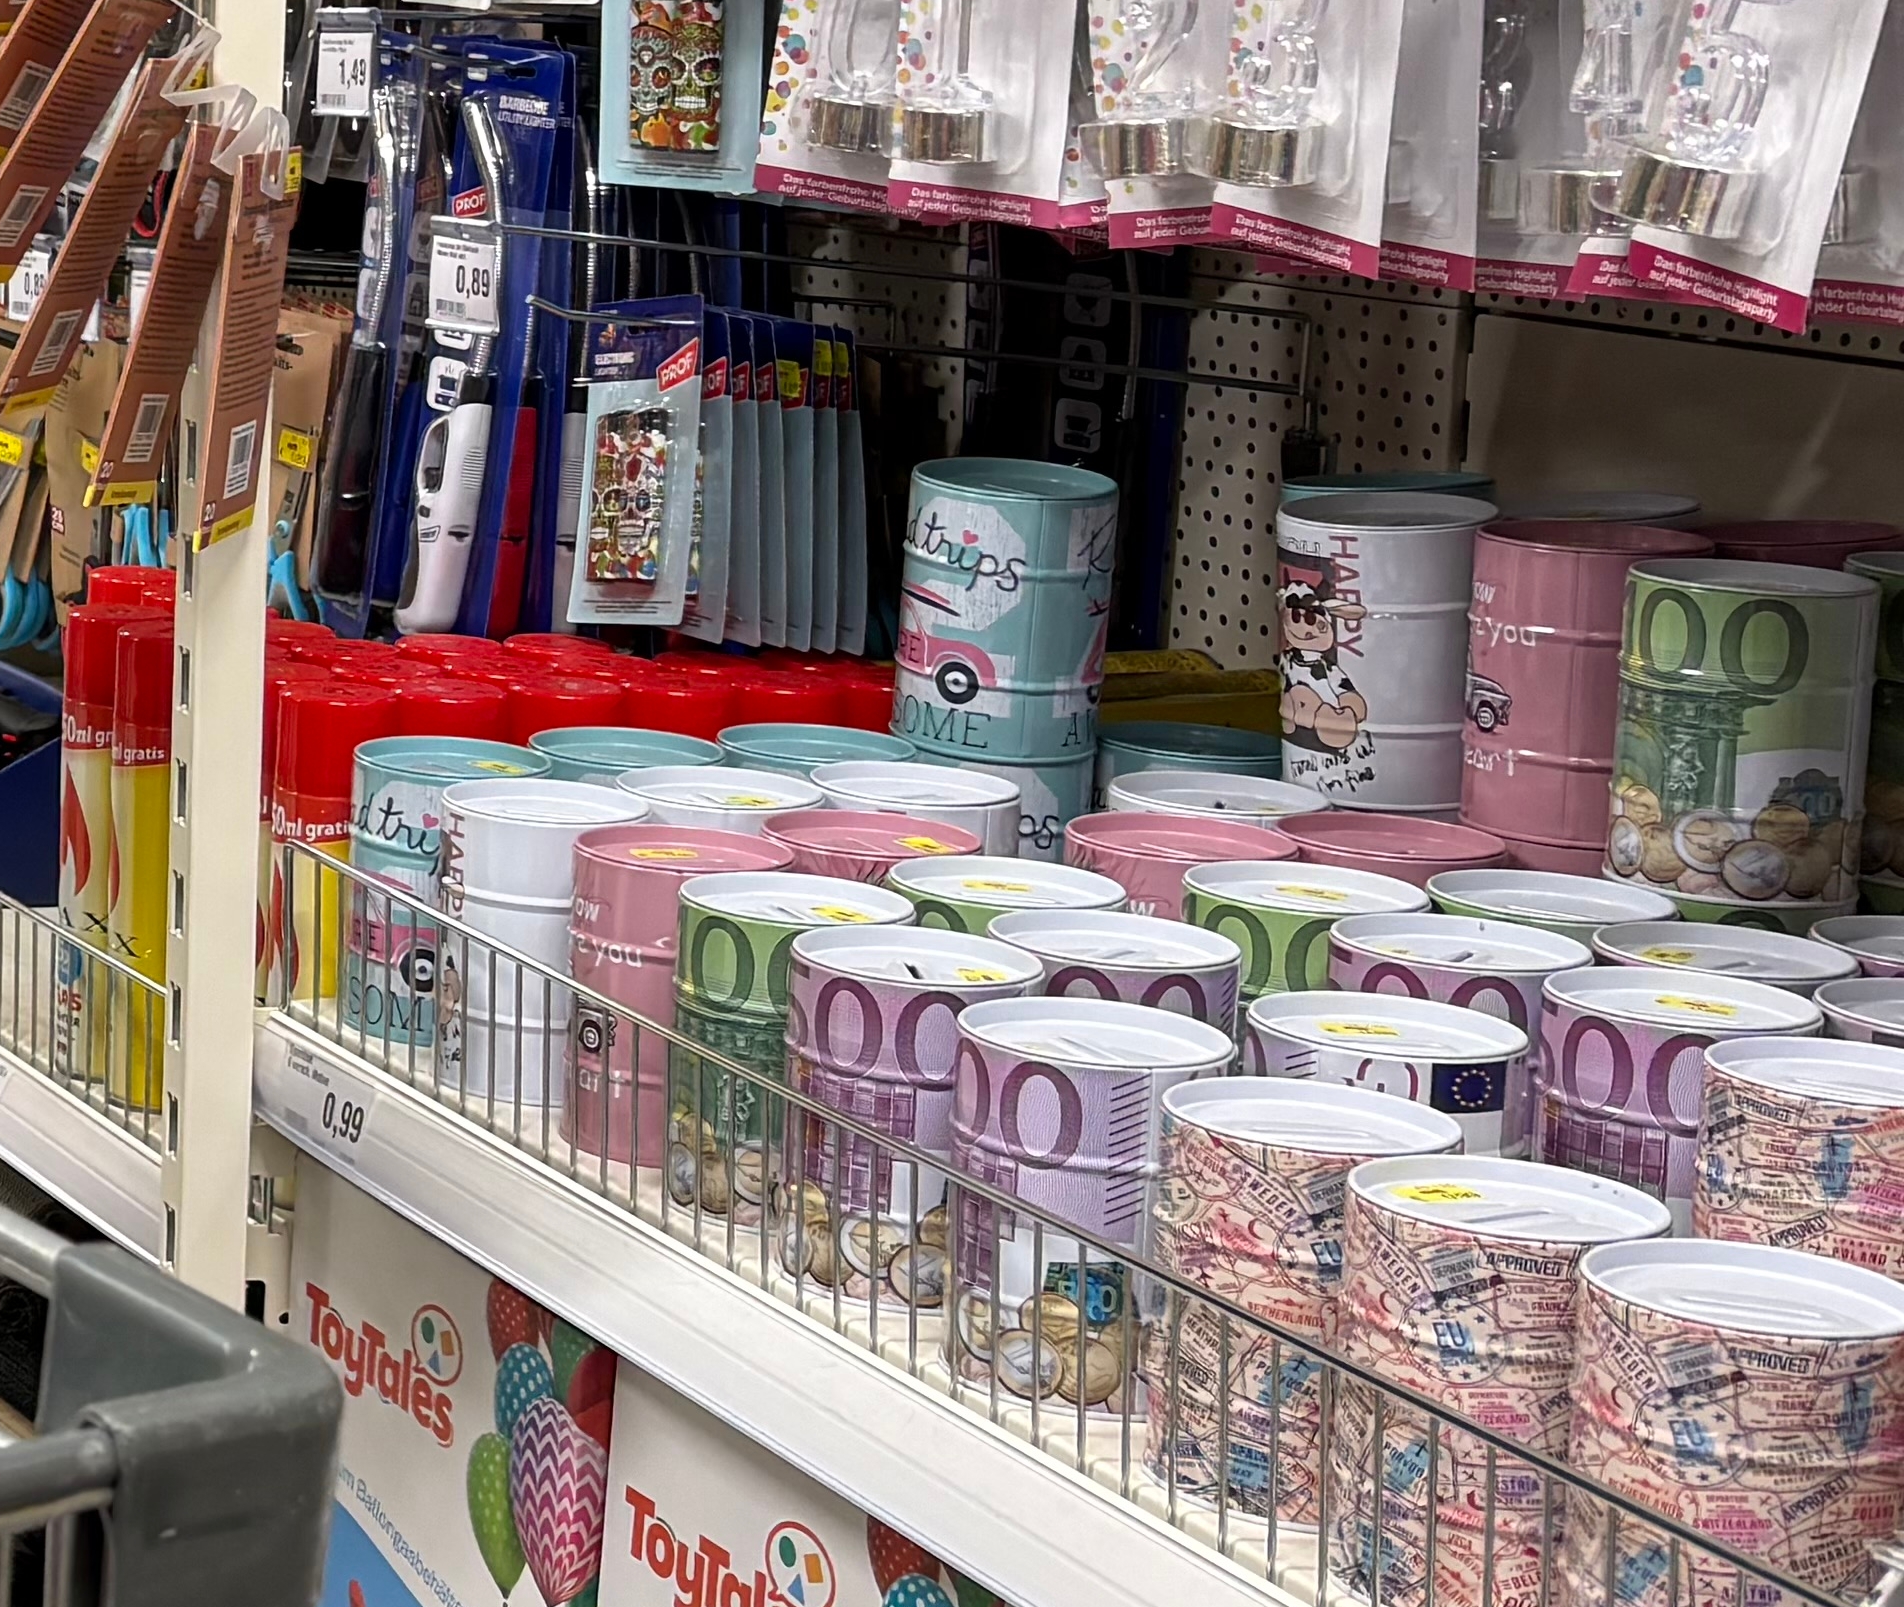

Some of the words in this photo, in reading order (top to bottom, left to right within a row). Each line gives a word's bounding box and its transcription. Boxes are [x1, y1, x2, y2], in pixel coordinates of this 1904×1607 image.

[455, 264, 491, 300] 0,89
[661, 351, 695, 386] PROF
[123, 746, 165, 766] gratis
[305, 817, 352, 845] grati
[323, 1091, 365, 1144] 0,99
[1485, 1251, 1563, 1278] APPROVED
[1832, 1245, 1888, 1266] POLAND
[305, 1282, 455, 1449] ToyTales
[1728, 1348, 1811, 1374] APPROVED
[624, 1485, 784, 1607] ToyTal
